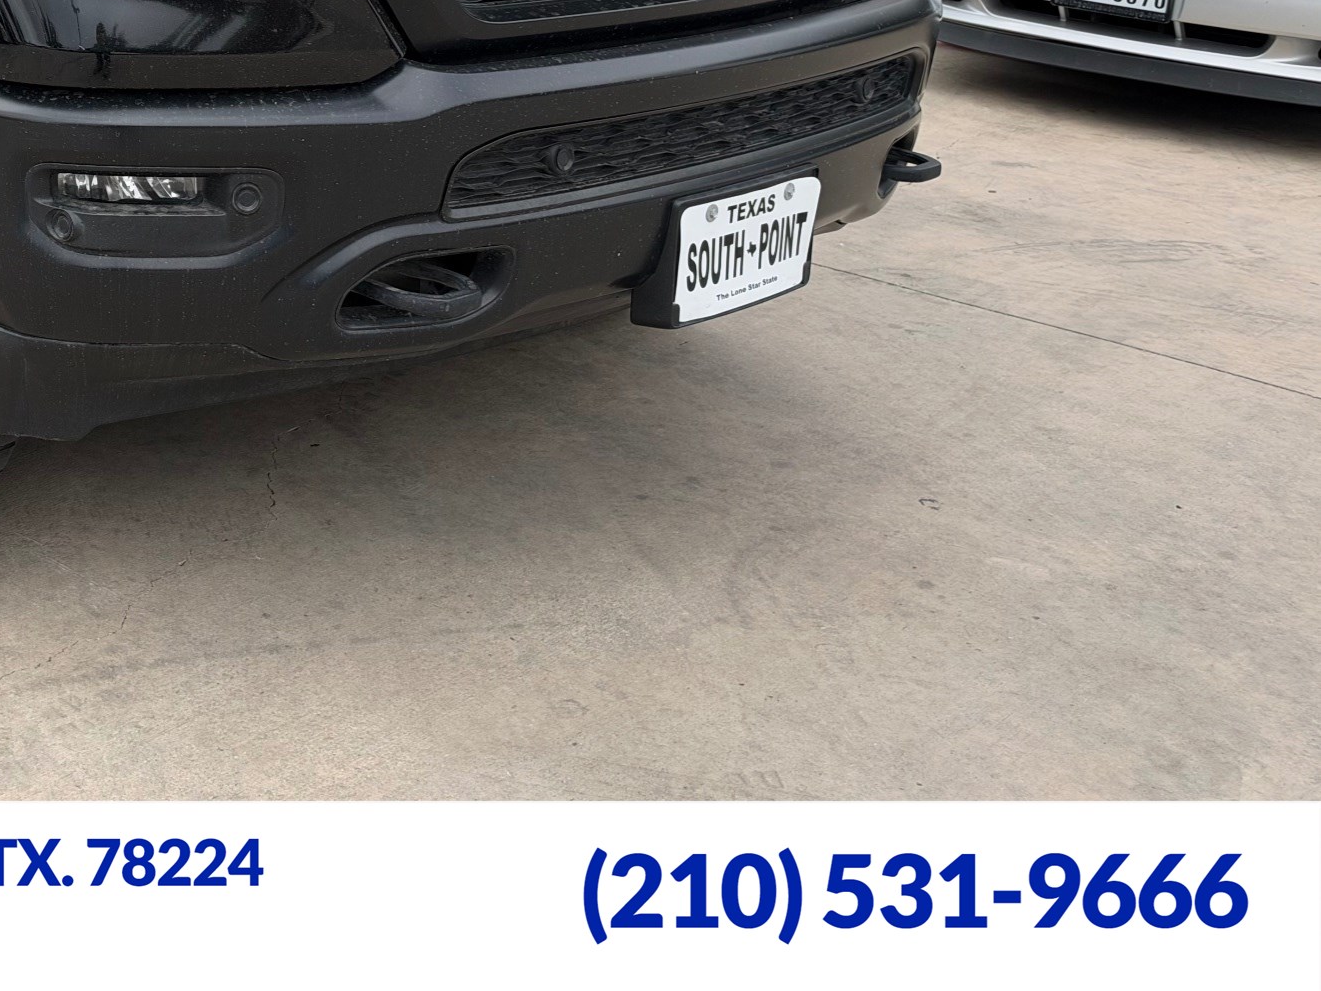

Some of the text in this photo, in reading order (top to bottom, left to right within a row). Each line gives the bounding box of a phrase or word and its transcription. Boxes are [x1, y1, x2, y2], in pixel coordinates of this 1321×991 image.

[727, 194, 776, 223] TEXAS
[686, 211, 808, 292] SOUTH POINT
[716, 275, 778, 301] The Lone Star State
